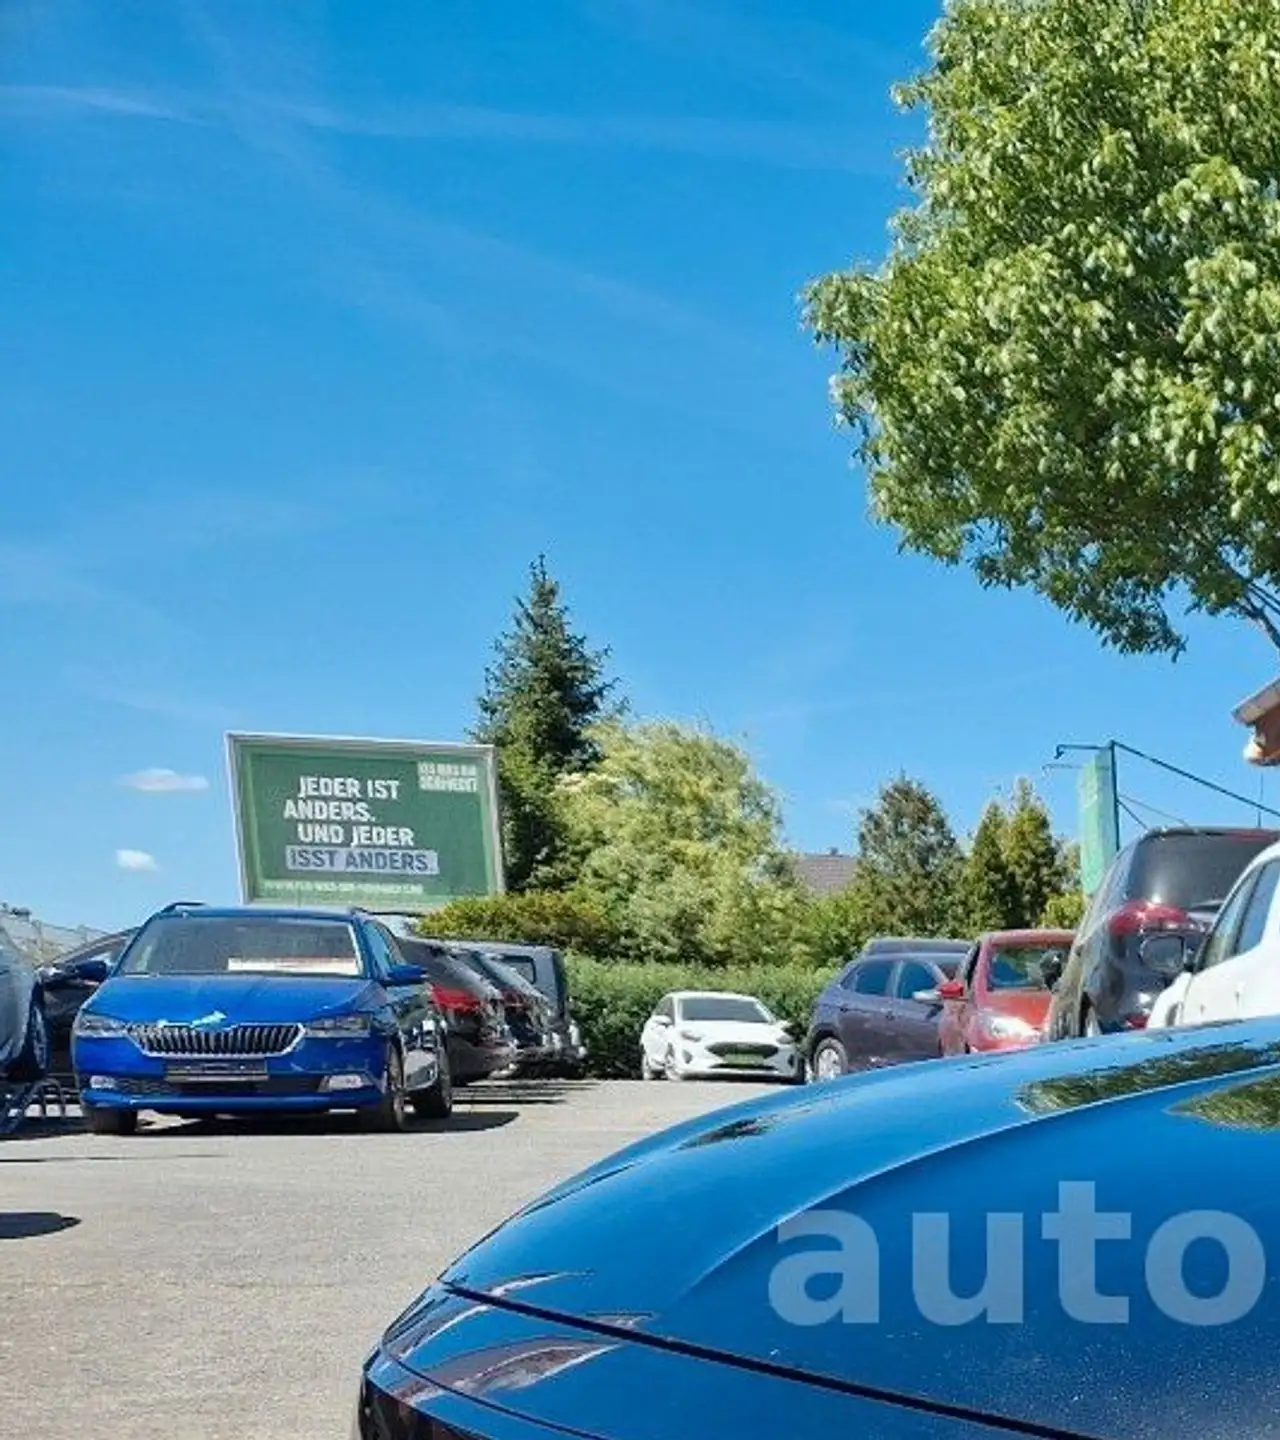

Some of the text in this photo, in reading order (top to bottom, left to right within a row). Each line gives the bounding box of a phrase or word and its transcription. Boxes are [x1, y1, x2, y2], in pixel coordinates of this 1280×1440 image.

[298, 775, 401, 800] JEDER IST
[283, 799, 376, 822] ANDERS.
[297, 822, 415, 847] UND JEDER
[290, 848, 337, 869] ISST
